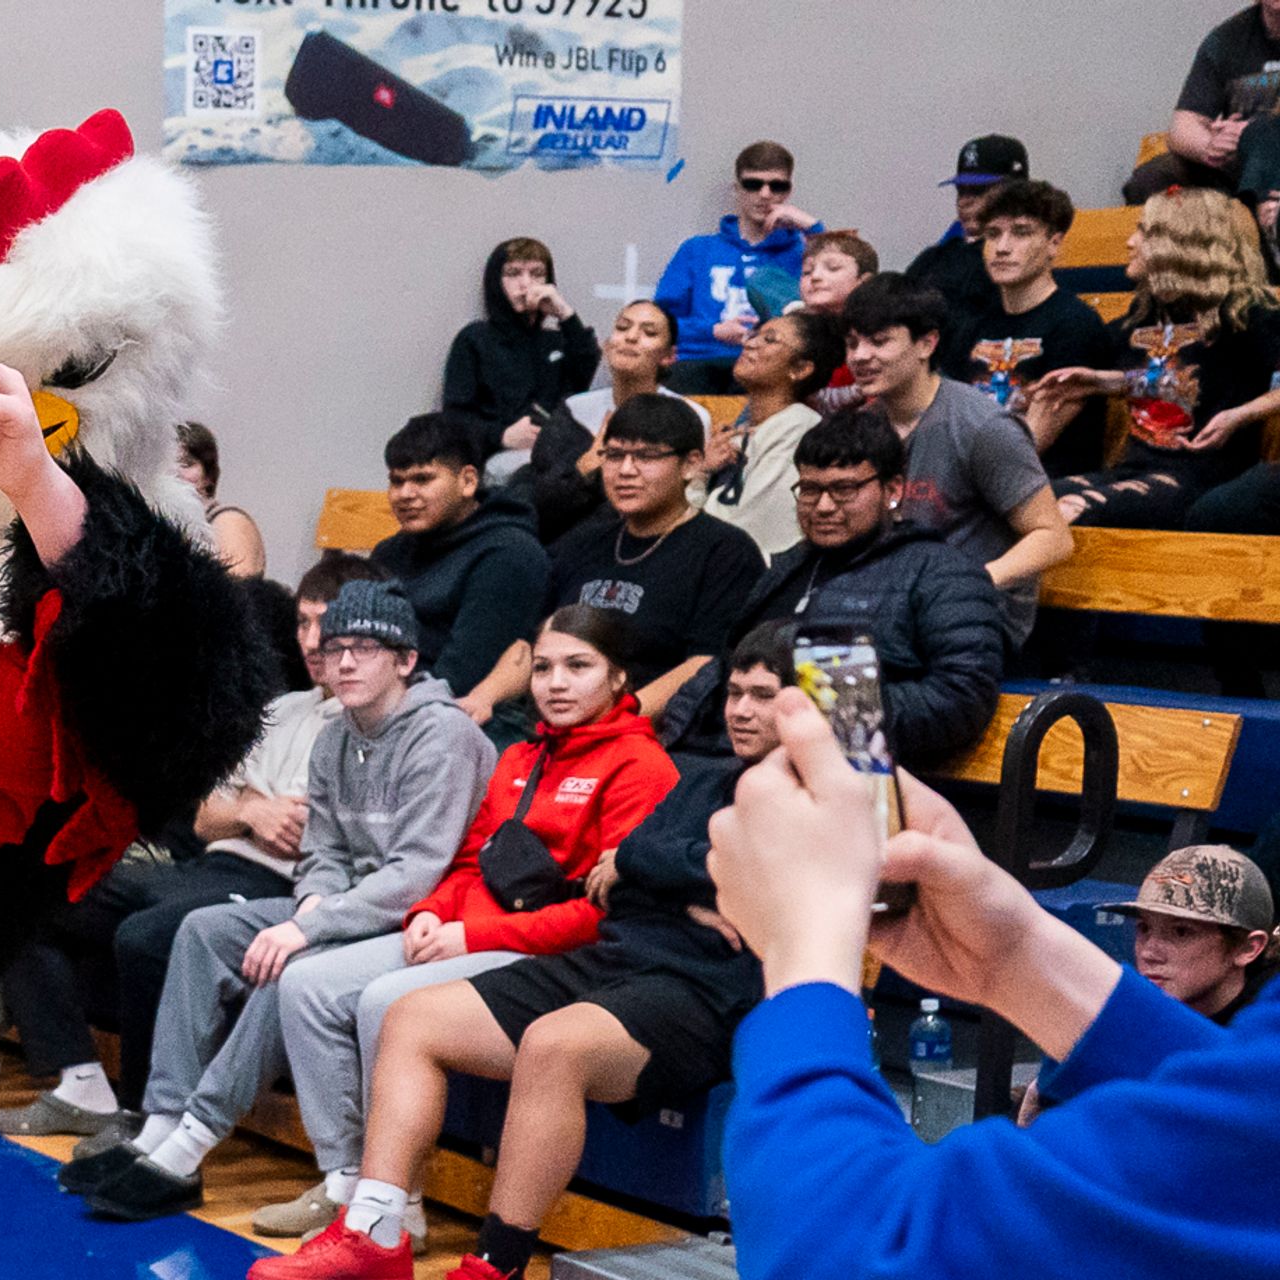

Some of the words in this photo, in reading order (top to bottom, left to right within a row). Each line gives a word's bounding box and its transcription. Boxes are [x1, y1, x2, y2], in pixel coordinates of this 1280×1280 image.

[495, 43, 538, 68] Win
[543, 53, 556, 70] a
[561, 47, 603, 71] JBL
[607, 48, 649, 78] Flip
[653, 51, 667, 73] 6
[532, 103, 647, 132] INLAND
